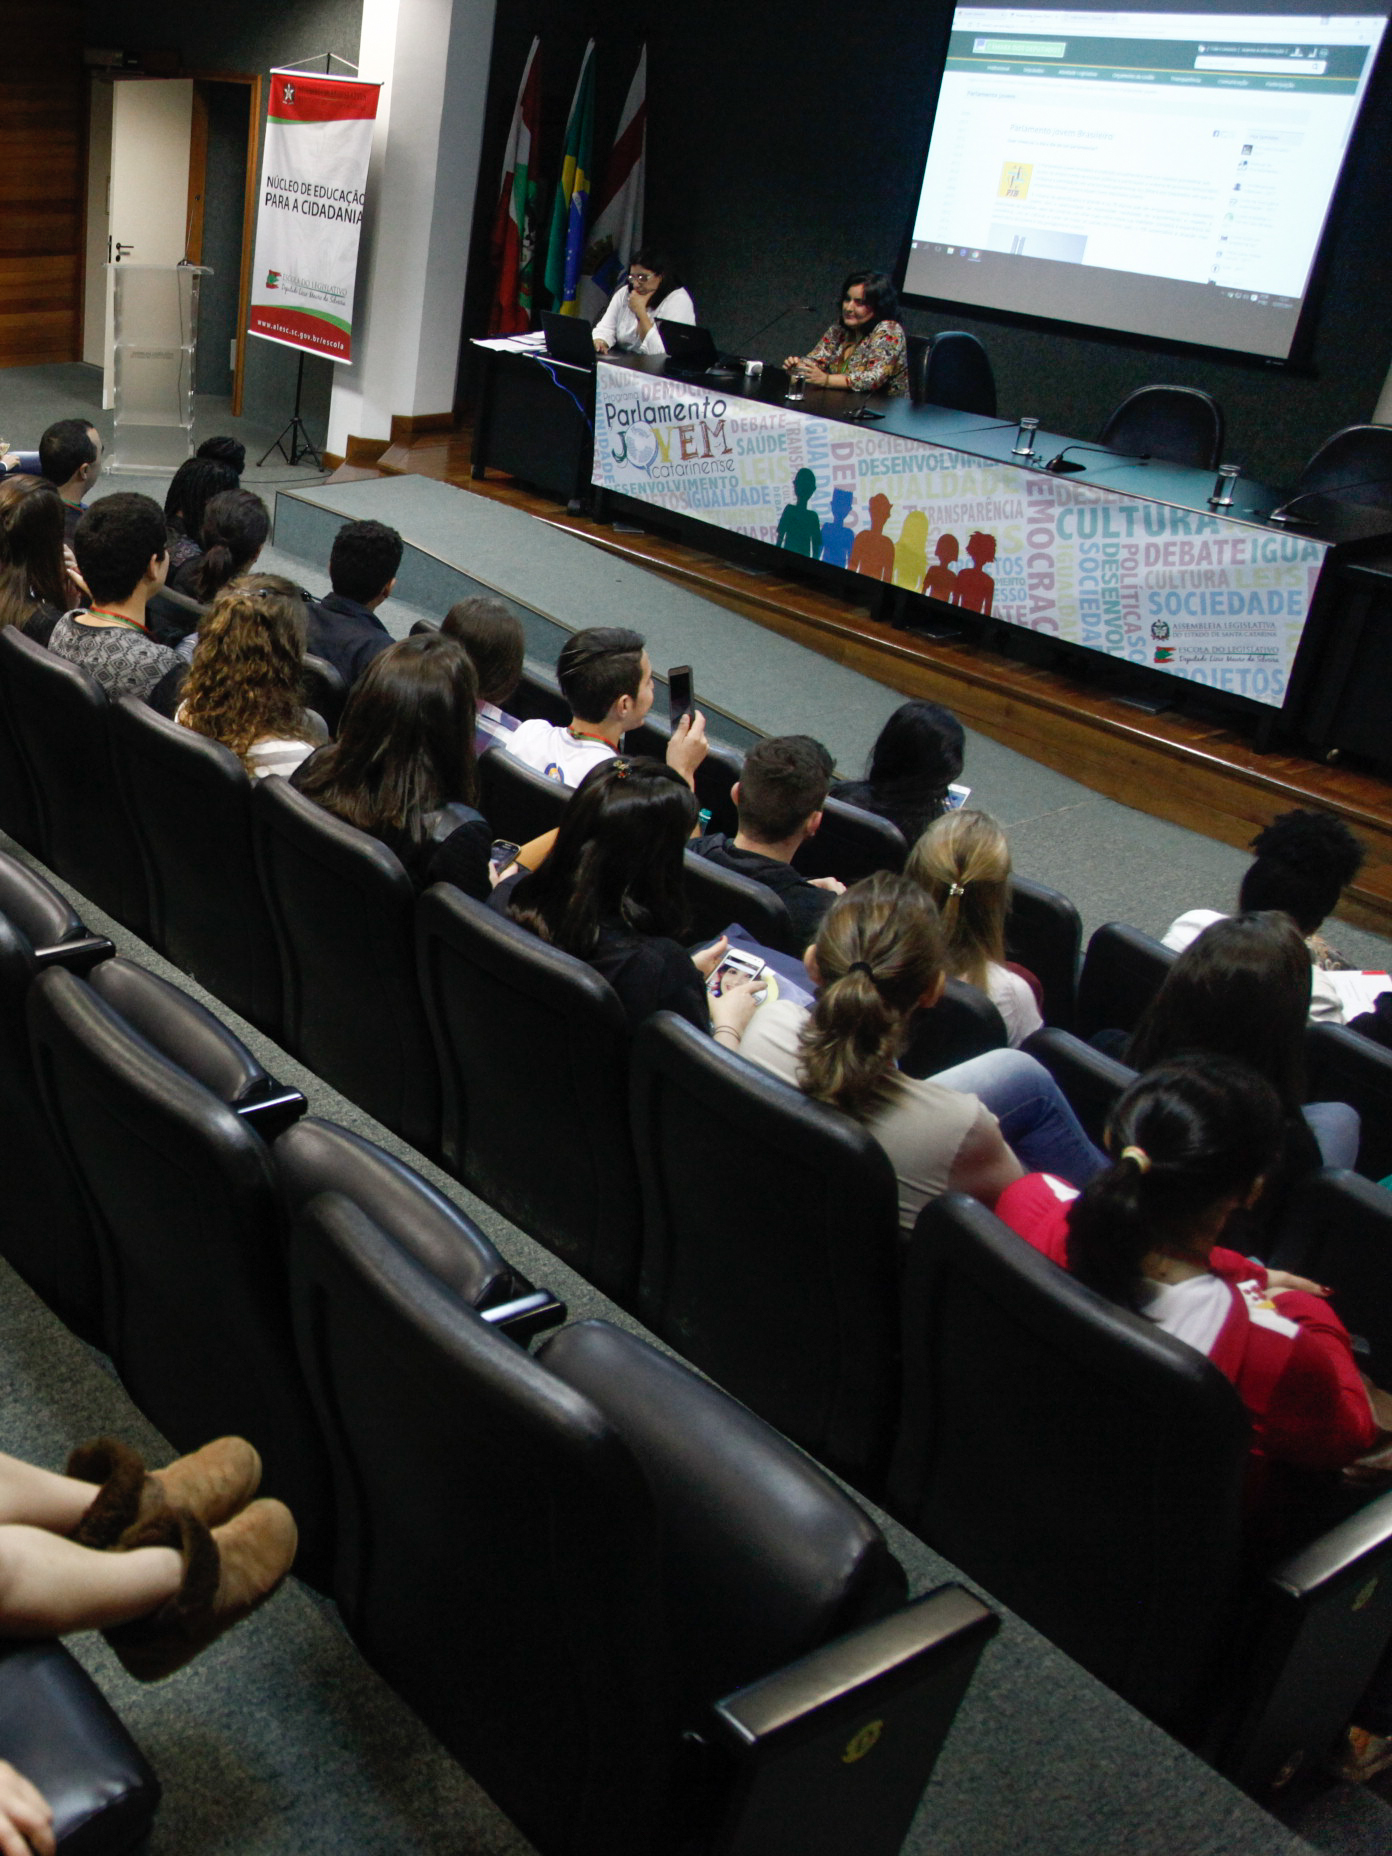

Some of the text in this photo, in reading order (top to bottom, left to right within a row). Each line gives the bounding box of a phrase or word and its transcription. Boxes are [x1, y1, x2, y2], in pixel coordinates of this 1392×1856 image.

[1009, 123, 1051, 135] Parlamento
[266, 174, 366, 207] NÚCLEO DE EDUCAÇÃO
[264, 192, 364, 225] PARA A CIDADANIA
[257, 319, 345, 351] www.alesc.sc.gov.br/escola
[602, 391, 639, 404] Programa
[604, 396, 727, 428] Parlamento
[730, 413, 786, 434] DEBATE
[611, 419, 733, 469] JOVEM
[736, 429, 788, 456] SAÚDE
[651, 458, 736, 480] catarinense
[737, 454, 792, 486] LEIS
[687, 485, 771, 509] IGUALDADE
[860, 466, 1021, 503] IGUALDADE
[1055, 502, 1221, 541] CULTURA
[1144, 536, 1322, 568] DEBATE IGUA
[1119, 543, 1143, 636] POLÍTICA
[1144, 565, 1306, 591] CULTURA LEIS
[1148, 590, 1304, 617] SOCIEDADE
[1172, 621, 1276, 630] ASSEMBLEIA LEGISLATIVA
[1227, 647, 1280, 655] LEGISLATIVO
